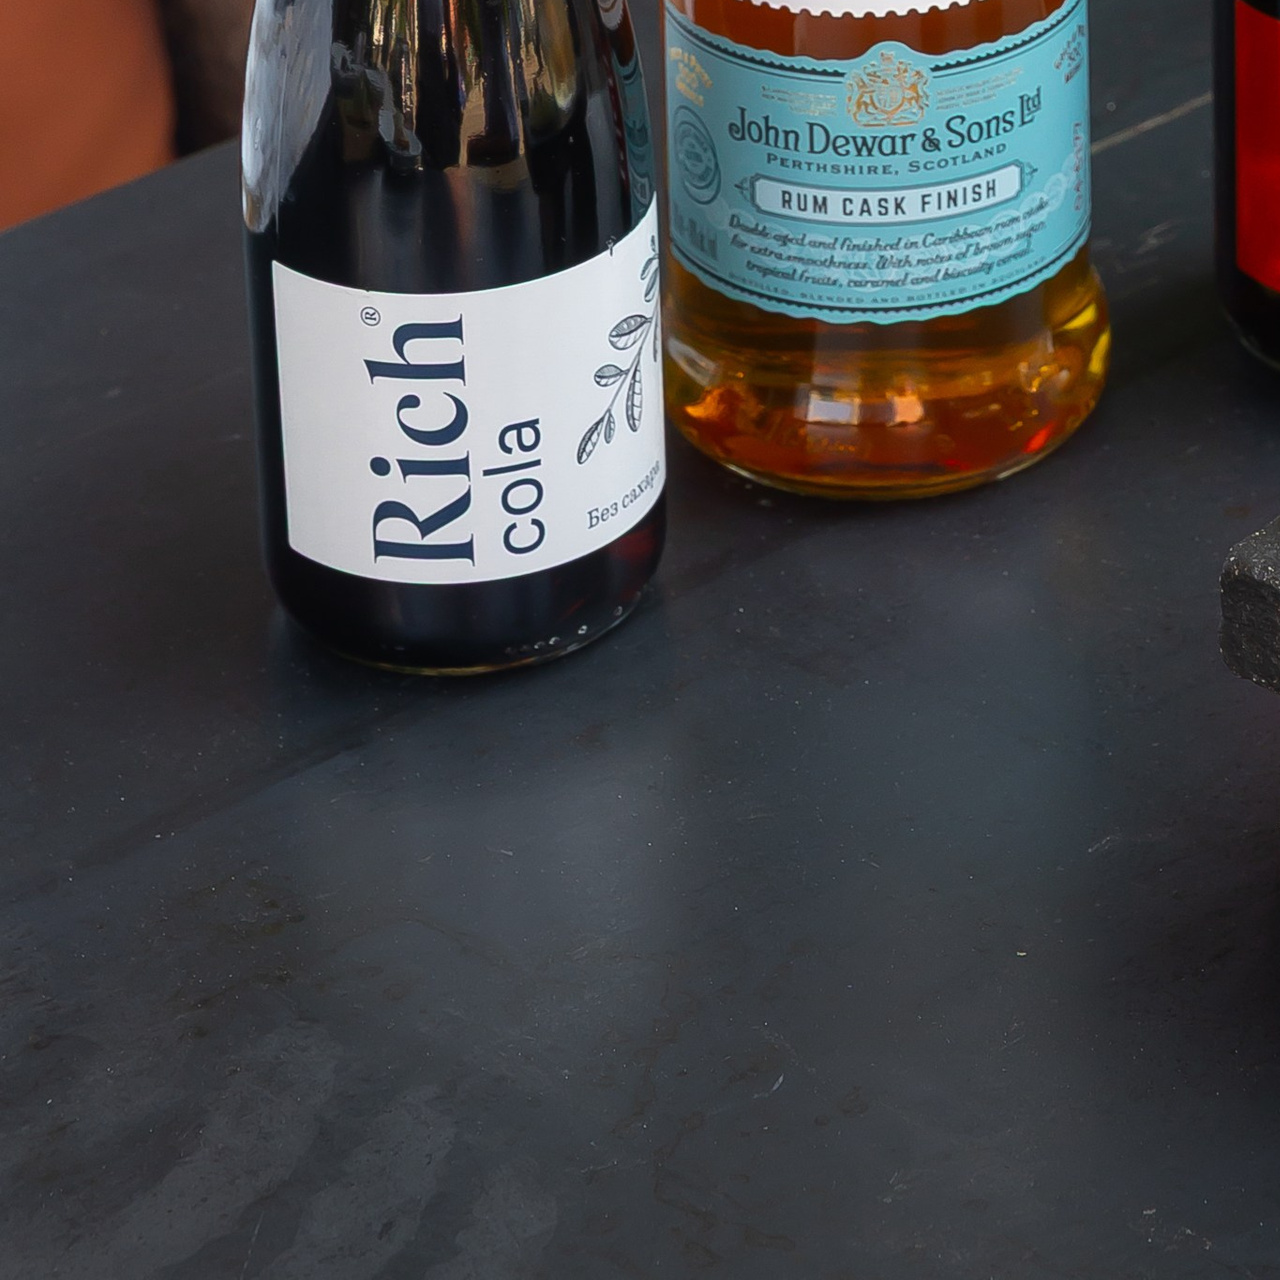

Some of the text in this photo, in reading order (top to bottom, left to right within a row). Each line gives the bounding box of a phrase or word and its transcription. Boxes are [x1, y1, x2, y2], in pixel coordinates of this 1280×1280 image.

[728, 105, 800, 152] John
[805, 121, 917, 157] Dewar
[921, 127, 942, 153] &
[945, 109, 1016, 149] Sons
[1017, 85, 1042, 129] Ltd
[766, 142, 1008, 177] PERTHSHIRE, SCOTLAND
[781, 178, 997, 217] RUM CASK FINISH
[808, 236, 839, 252] and
[840, 236, 901, 252] finished
[904, 237, 919, 249] in
[921, 227, 994, 249] Caribbean
[994, 215, 1021, 232] rum
[746, 260, 796, 280] tropical
[847, 271, 909, 288] caramel
[909, 267, 942, 284] and
[750, 244, 783, 260] extra
[875, 252, 912, 271] With
[915, 252, 951, 267] notes
[954, 243, 974, 261] of
[363, 313, 476, 567] Rich
[482, 417, 546, 555] cola
[587, 502, 619, 530] Без
